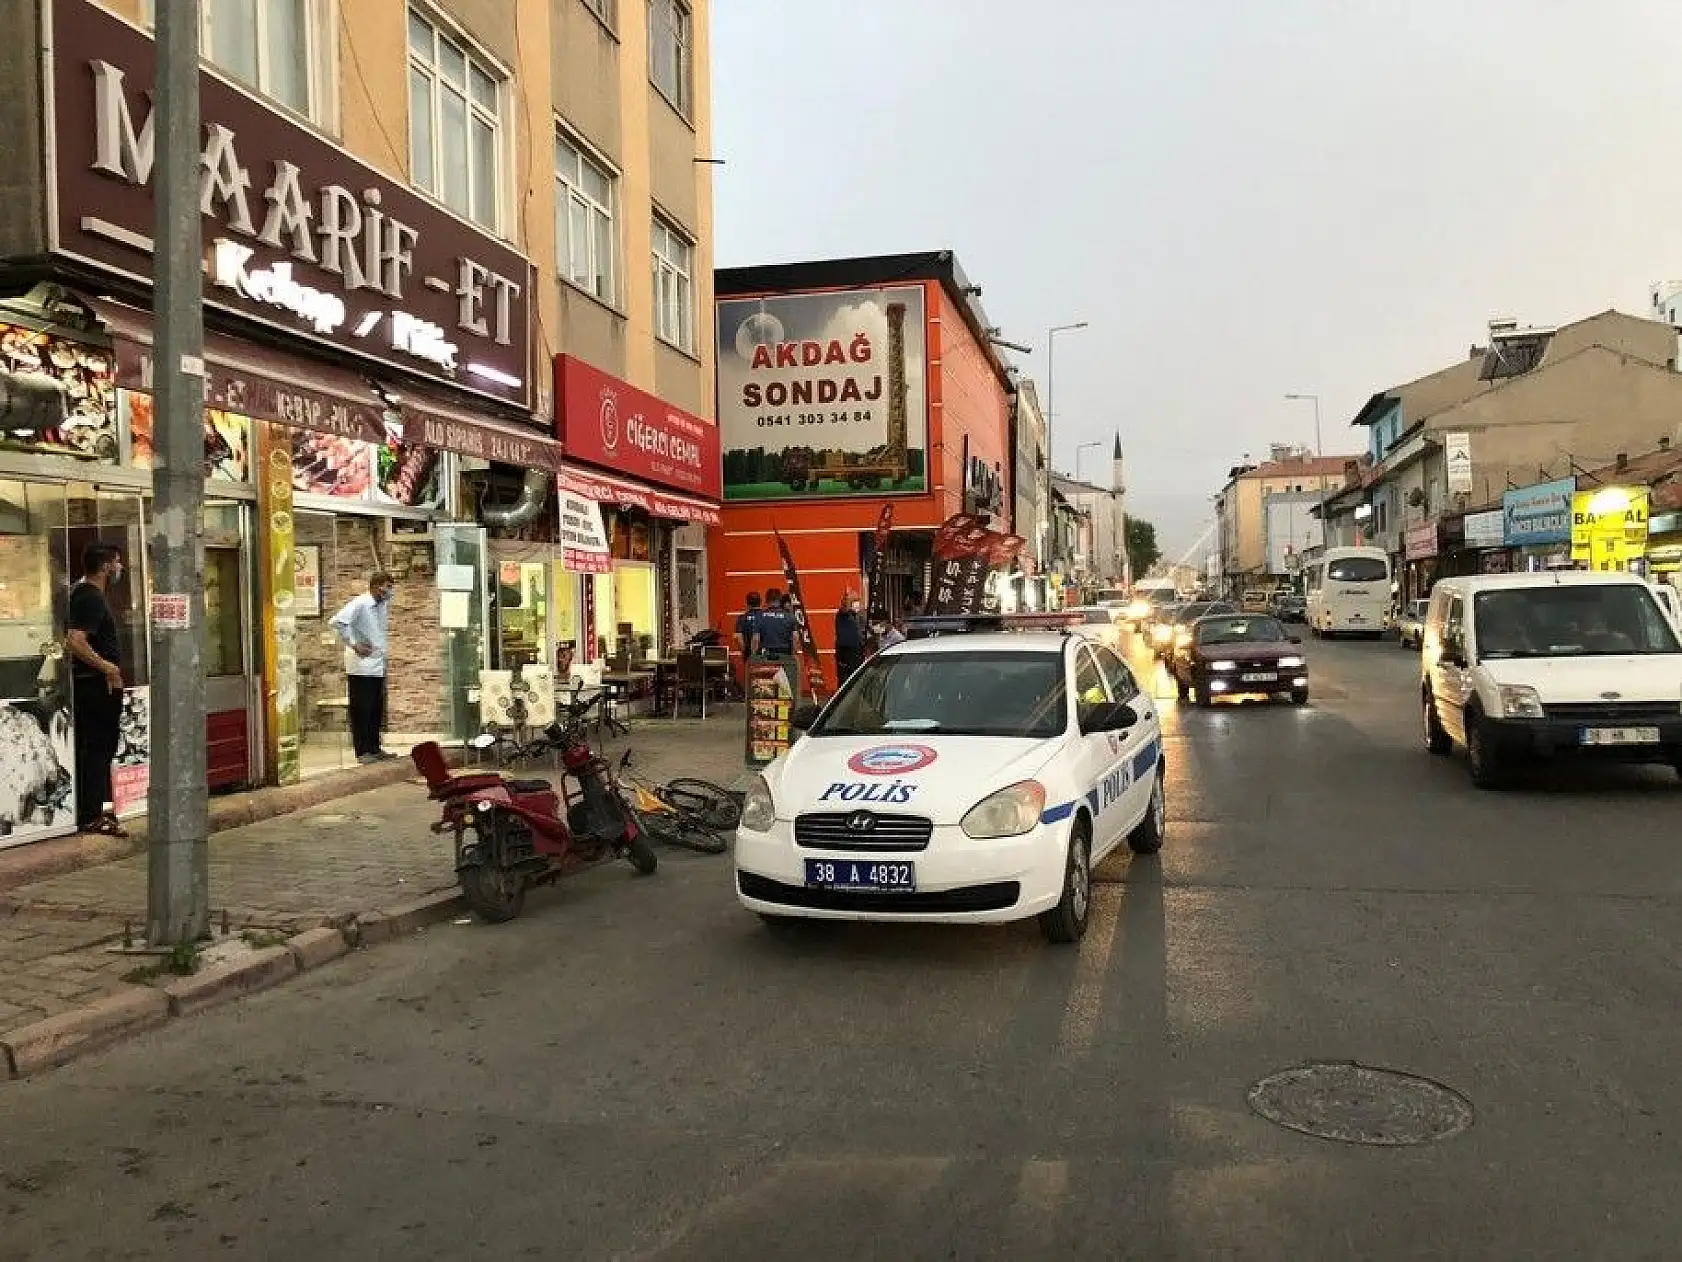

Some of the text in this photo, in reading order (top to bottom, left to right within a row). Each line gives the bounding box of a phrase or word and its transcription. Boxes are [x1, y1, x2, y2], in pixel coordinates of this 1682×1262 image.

[88, 58, 419, 299] MAARİF
[457, 258, 520, 345] ET
[751, 333, 872, 369] AKDAĞ
[743, 376, 882, 407] SONDAJ
[757, 411, 871, 427] 0541 303 34 84
[627, 413, 669, 457] CİĞERCİ
[670, 436, 702, 468] CEMAL
[1574, 509, 1646, 525] BAAL
[817, 779, 919, 803] POLİS
[815, 862, 910, 884] 38 A 4832
